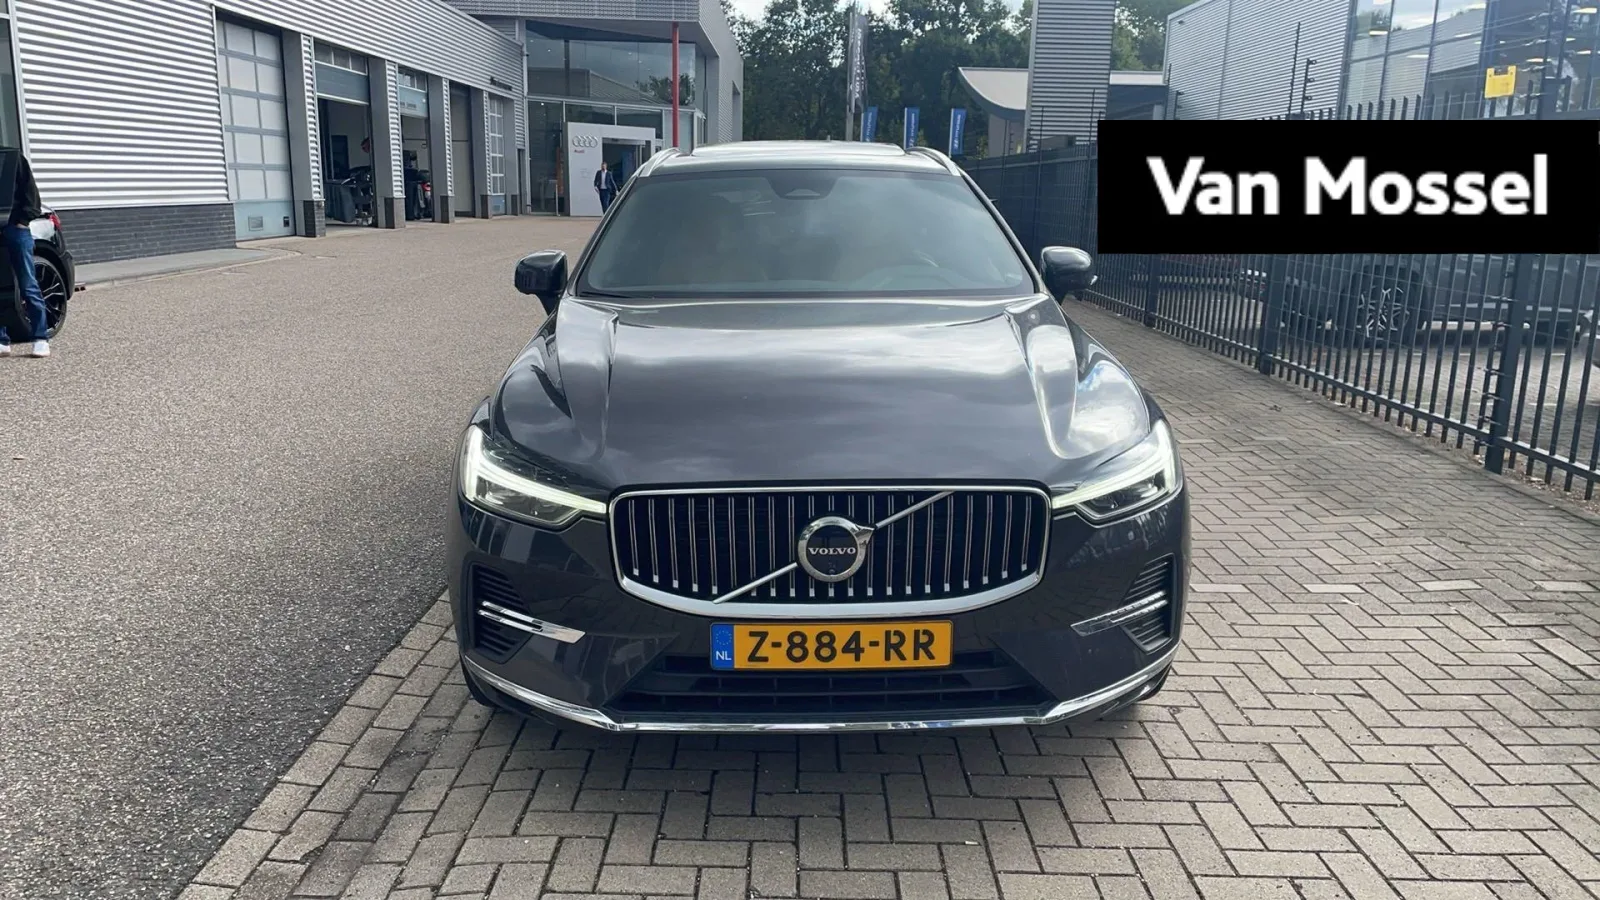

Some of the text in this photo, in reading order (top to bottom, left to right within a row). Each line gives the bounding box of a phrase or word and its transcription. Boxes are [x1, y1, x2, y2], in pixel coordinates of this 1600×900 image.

[808, 547, 856, 556] VOLVO
[747, 629, 936, 664] Z-884-RR
[715, 650, 732, 661] NL
